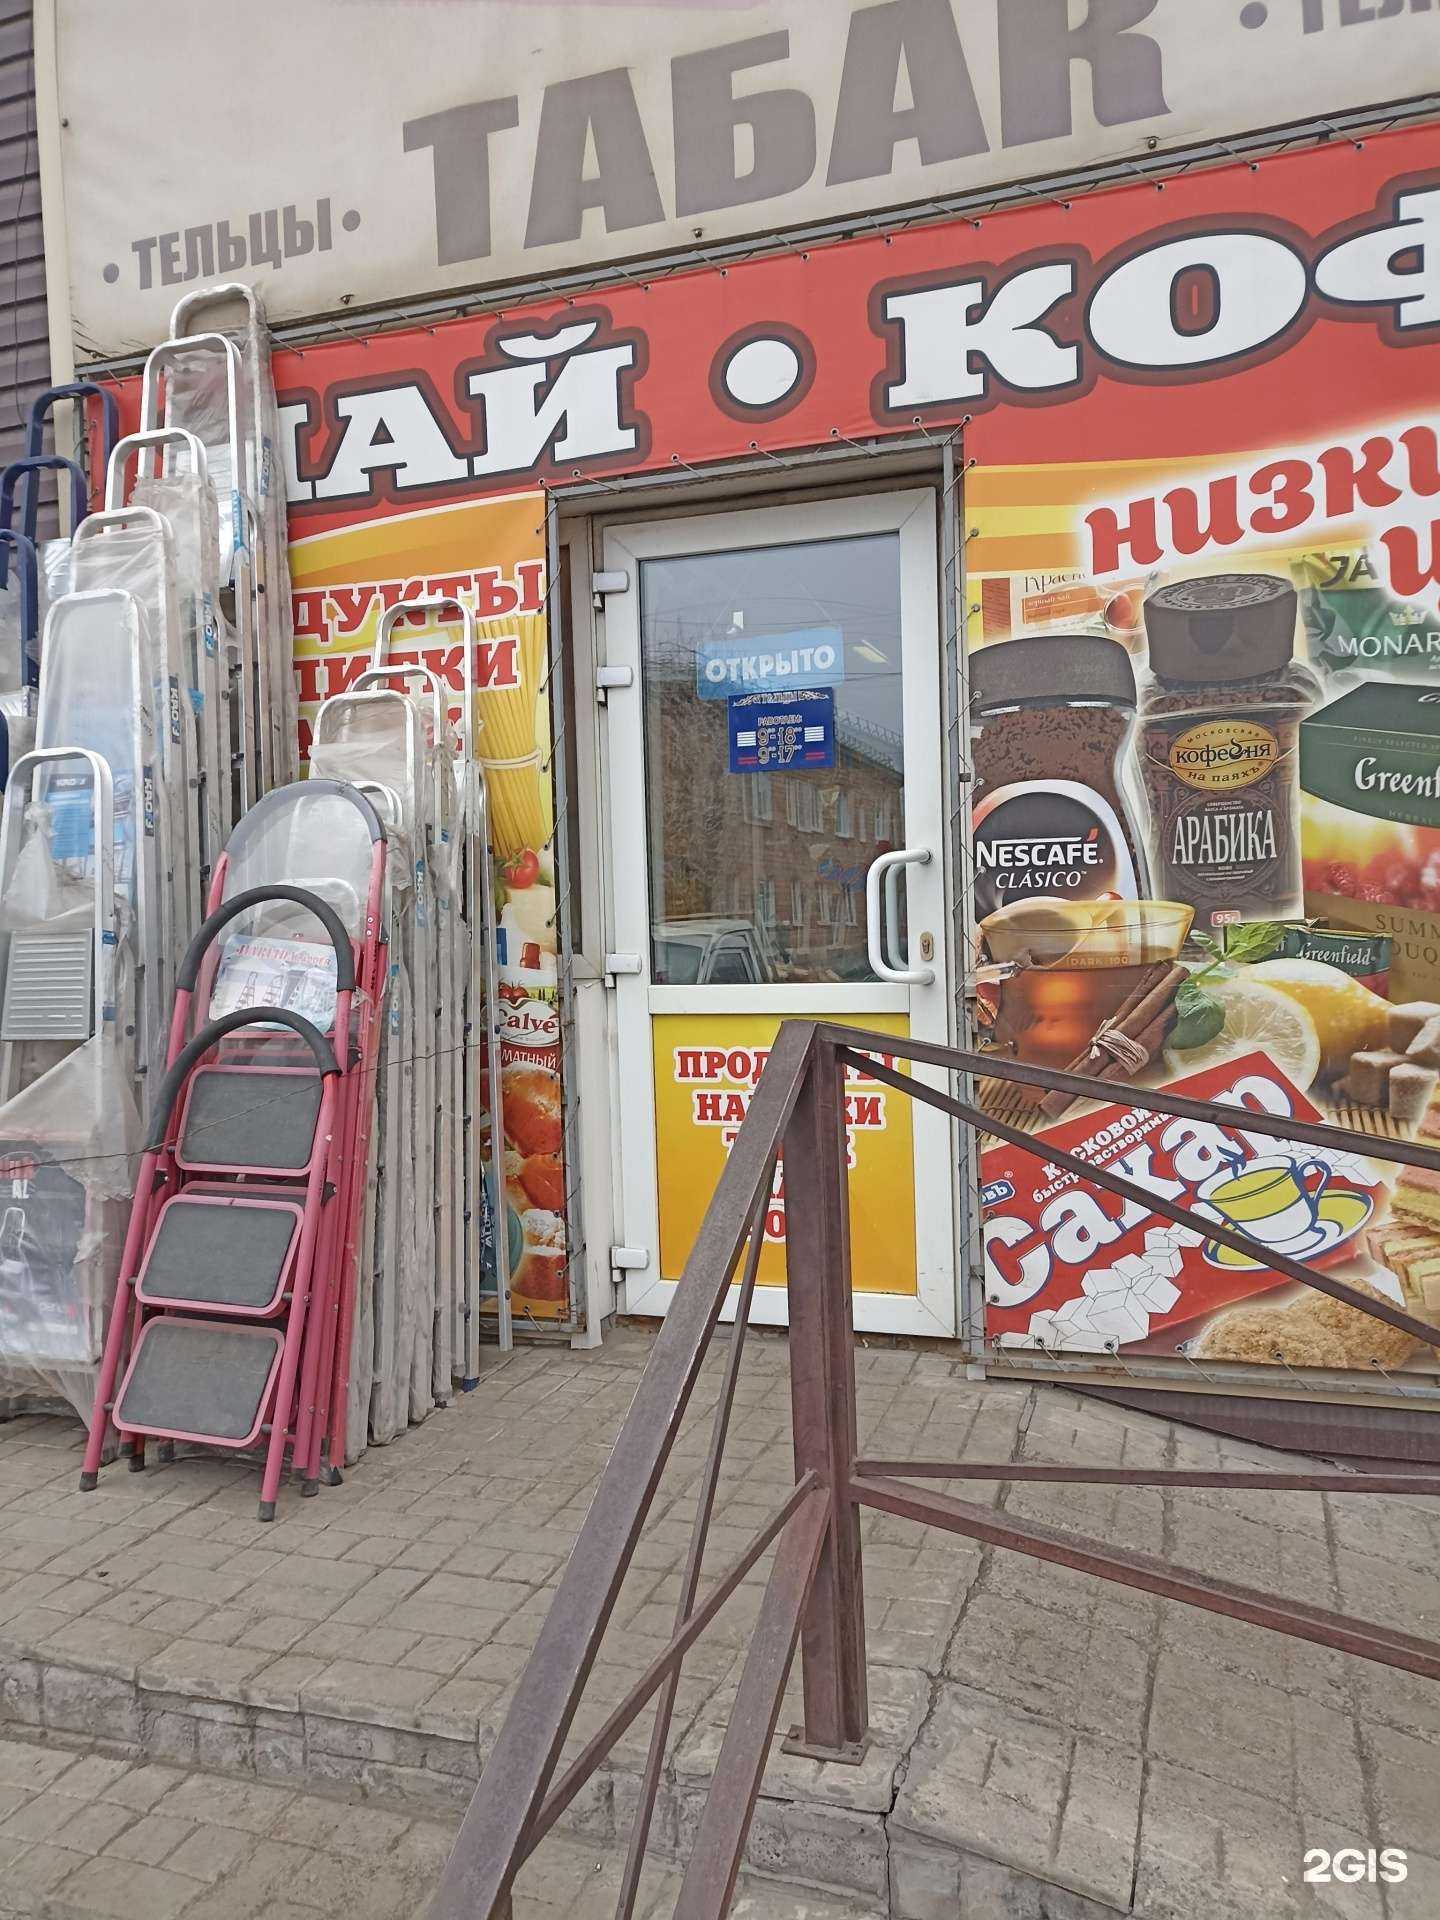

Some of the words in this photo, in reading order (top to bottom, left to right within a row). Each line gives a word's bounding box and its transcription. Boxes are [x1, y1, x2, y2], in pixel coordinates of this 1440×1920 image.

[131, 197, 334, 290] ТЕЛЬЦЫ
[403, 0, 1172, 267] ТАБАК
[280, 321, 637, 501] АЙ
[705, 645, 836, 683] ОТКРЫТО
[1172, 810, 1277, 864] АРАБИКА
[995, 869, 1081, 889] CLÁSICO
[1296, 942, 1371, 966] Greenfield
[1042, 1106, 1153, 1181] КСКОВОЙ
